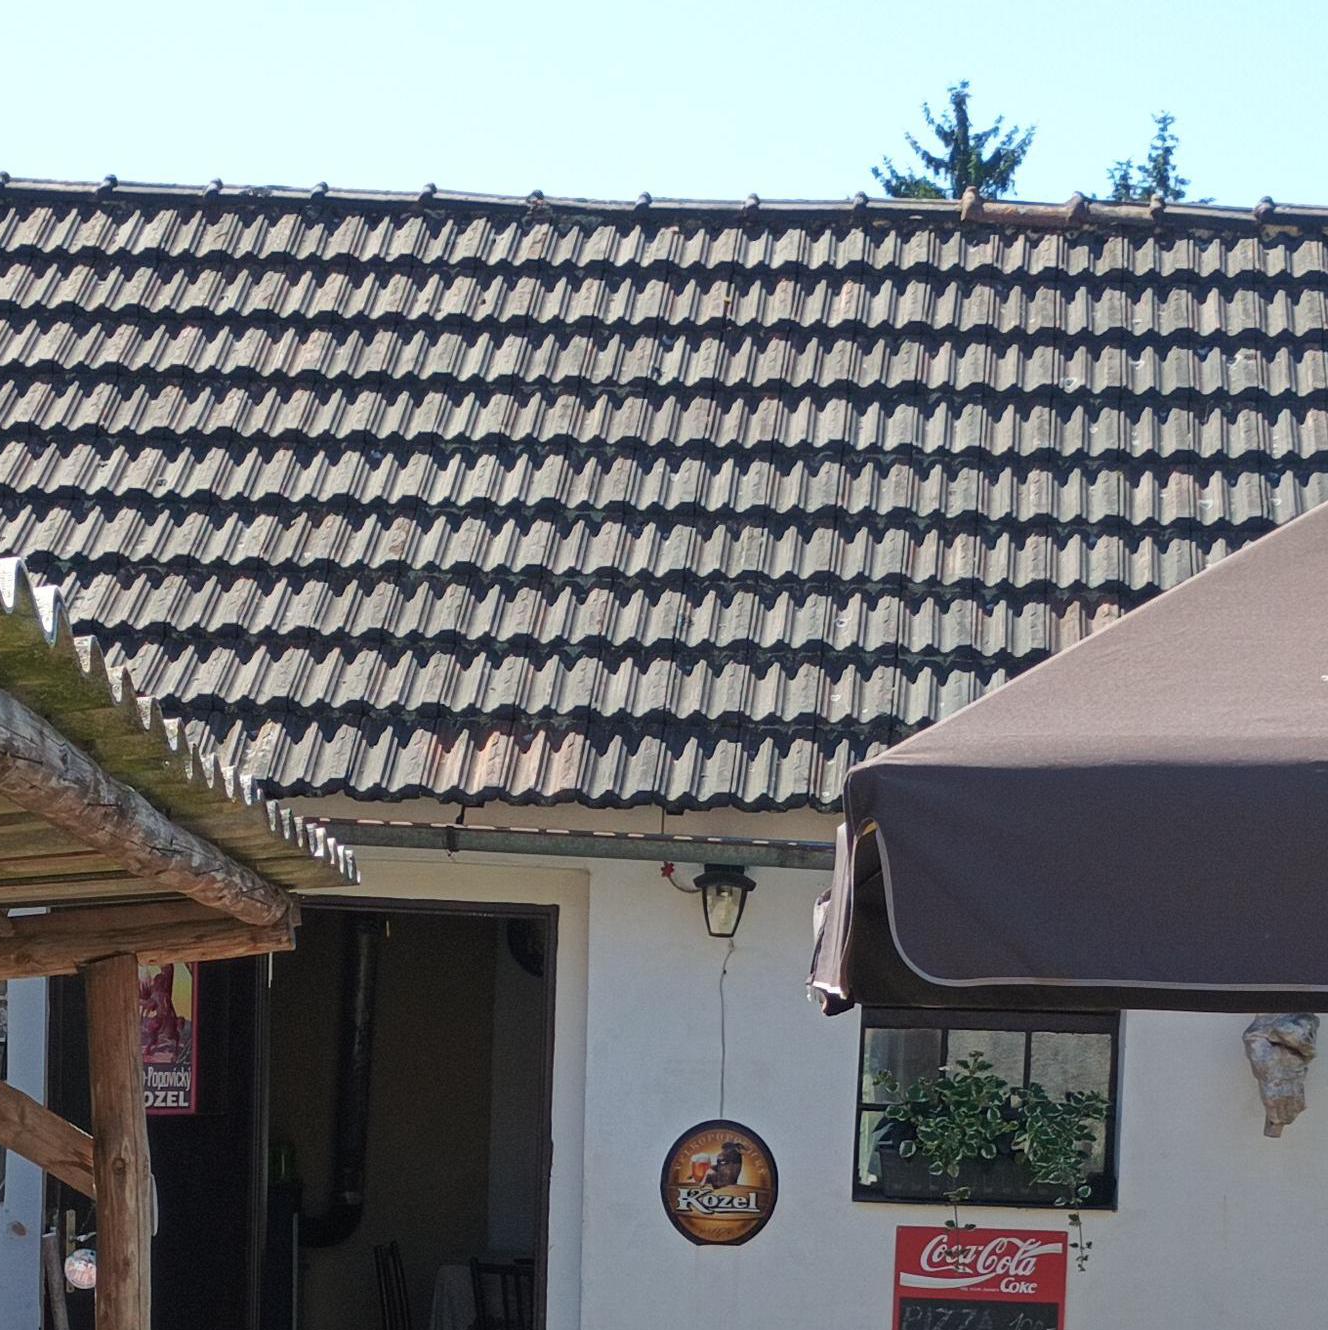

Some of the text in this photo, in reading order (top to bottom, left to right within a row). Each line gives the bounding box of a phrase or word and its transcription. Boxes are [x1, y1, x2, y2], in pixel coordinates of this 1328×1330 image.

[143, 1066, 191, 1092] -Popovický
[144, 1091, 189, 1107] OZEL
[676, 1184, 760, 1214] Kozel
[1000, 1277, 1037, 1294] Coke
